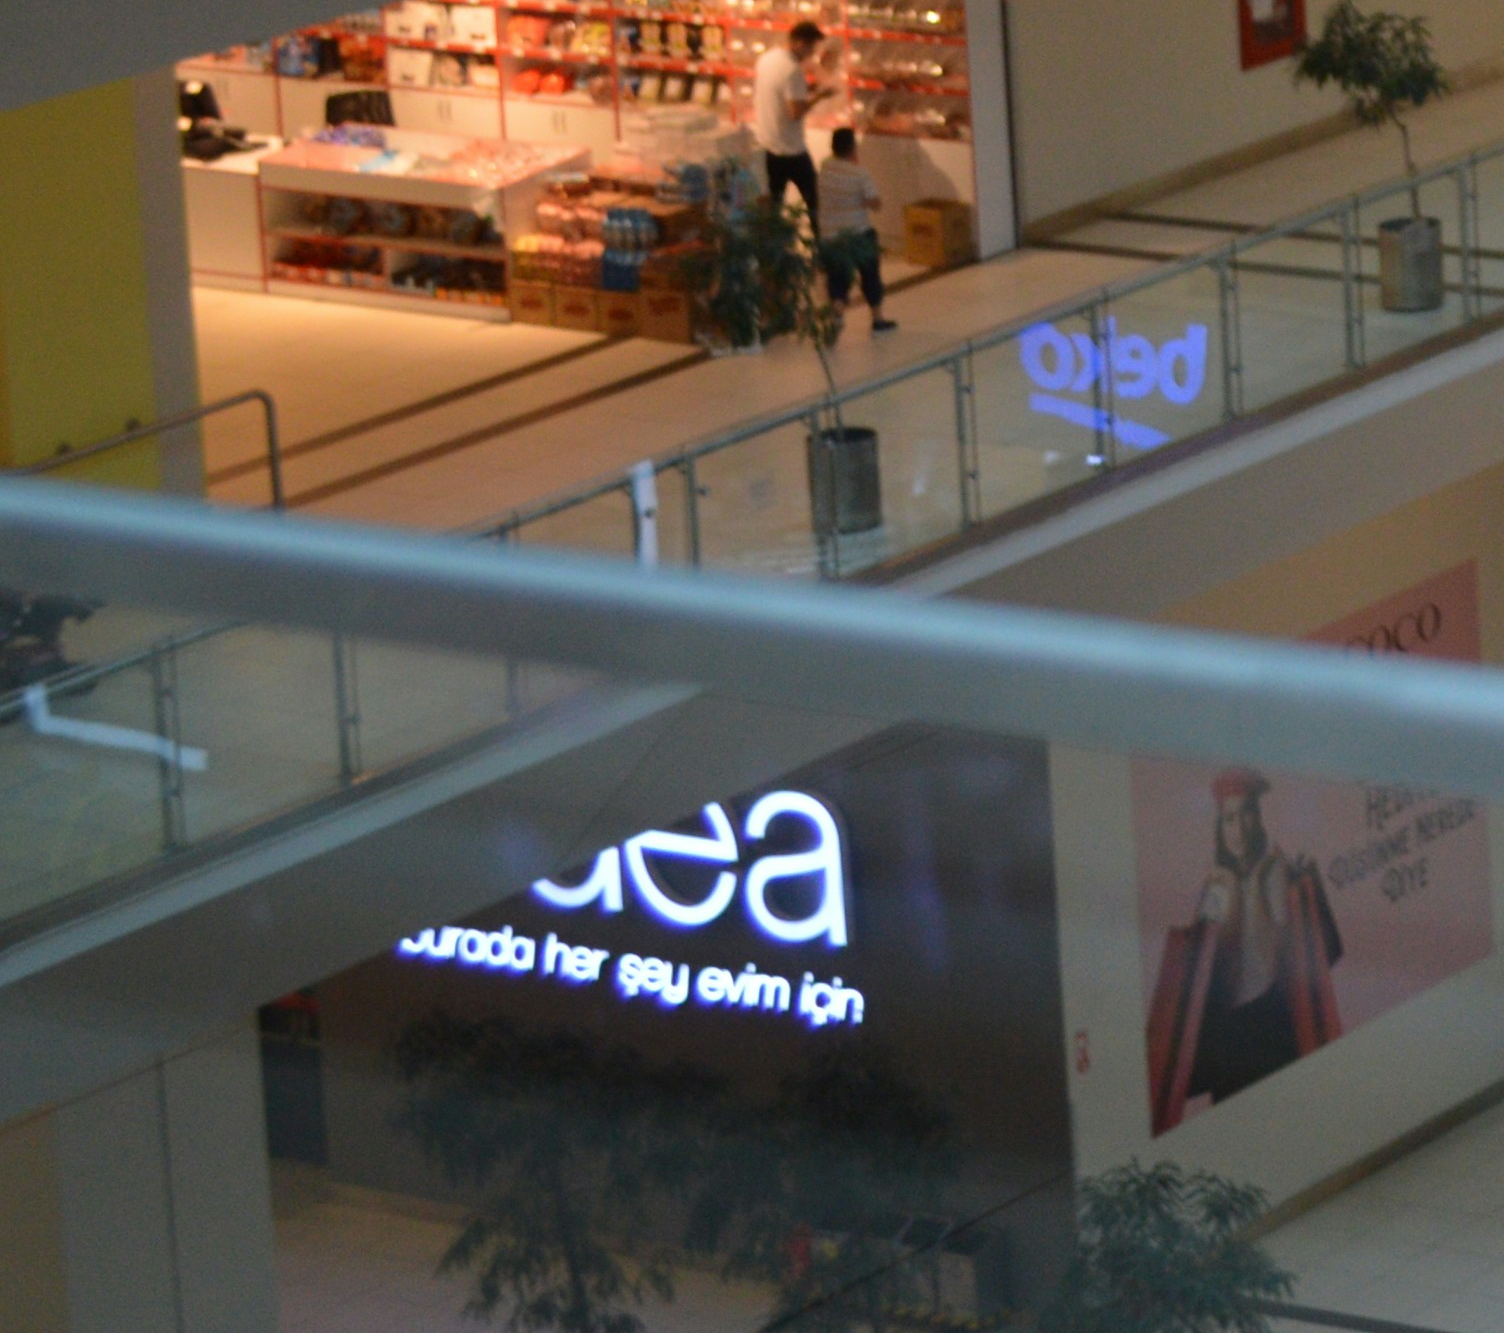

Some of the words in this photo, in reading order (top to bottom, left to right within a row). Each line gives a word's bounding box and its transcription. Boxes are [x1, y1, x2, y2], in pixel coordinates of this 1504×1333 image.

[543, 932, 610, 983] her
[617, 951, 690, 1006] şey
[695, 961, 792, 1013] evim
[799, 971, 866, 1027] için
